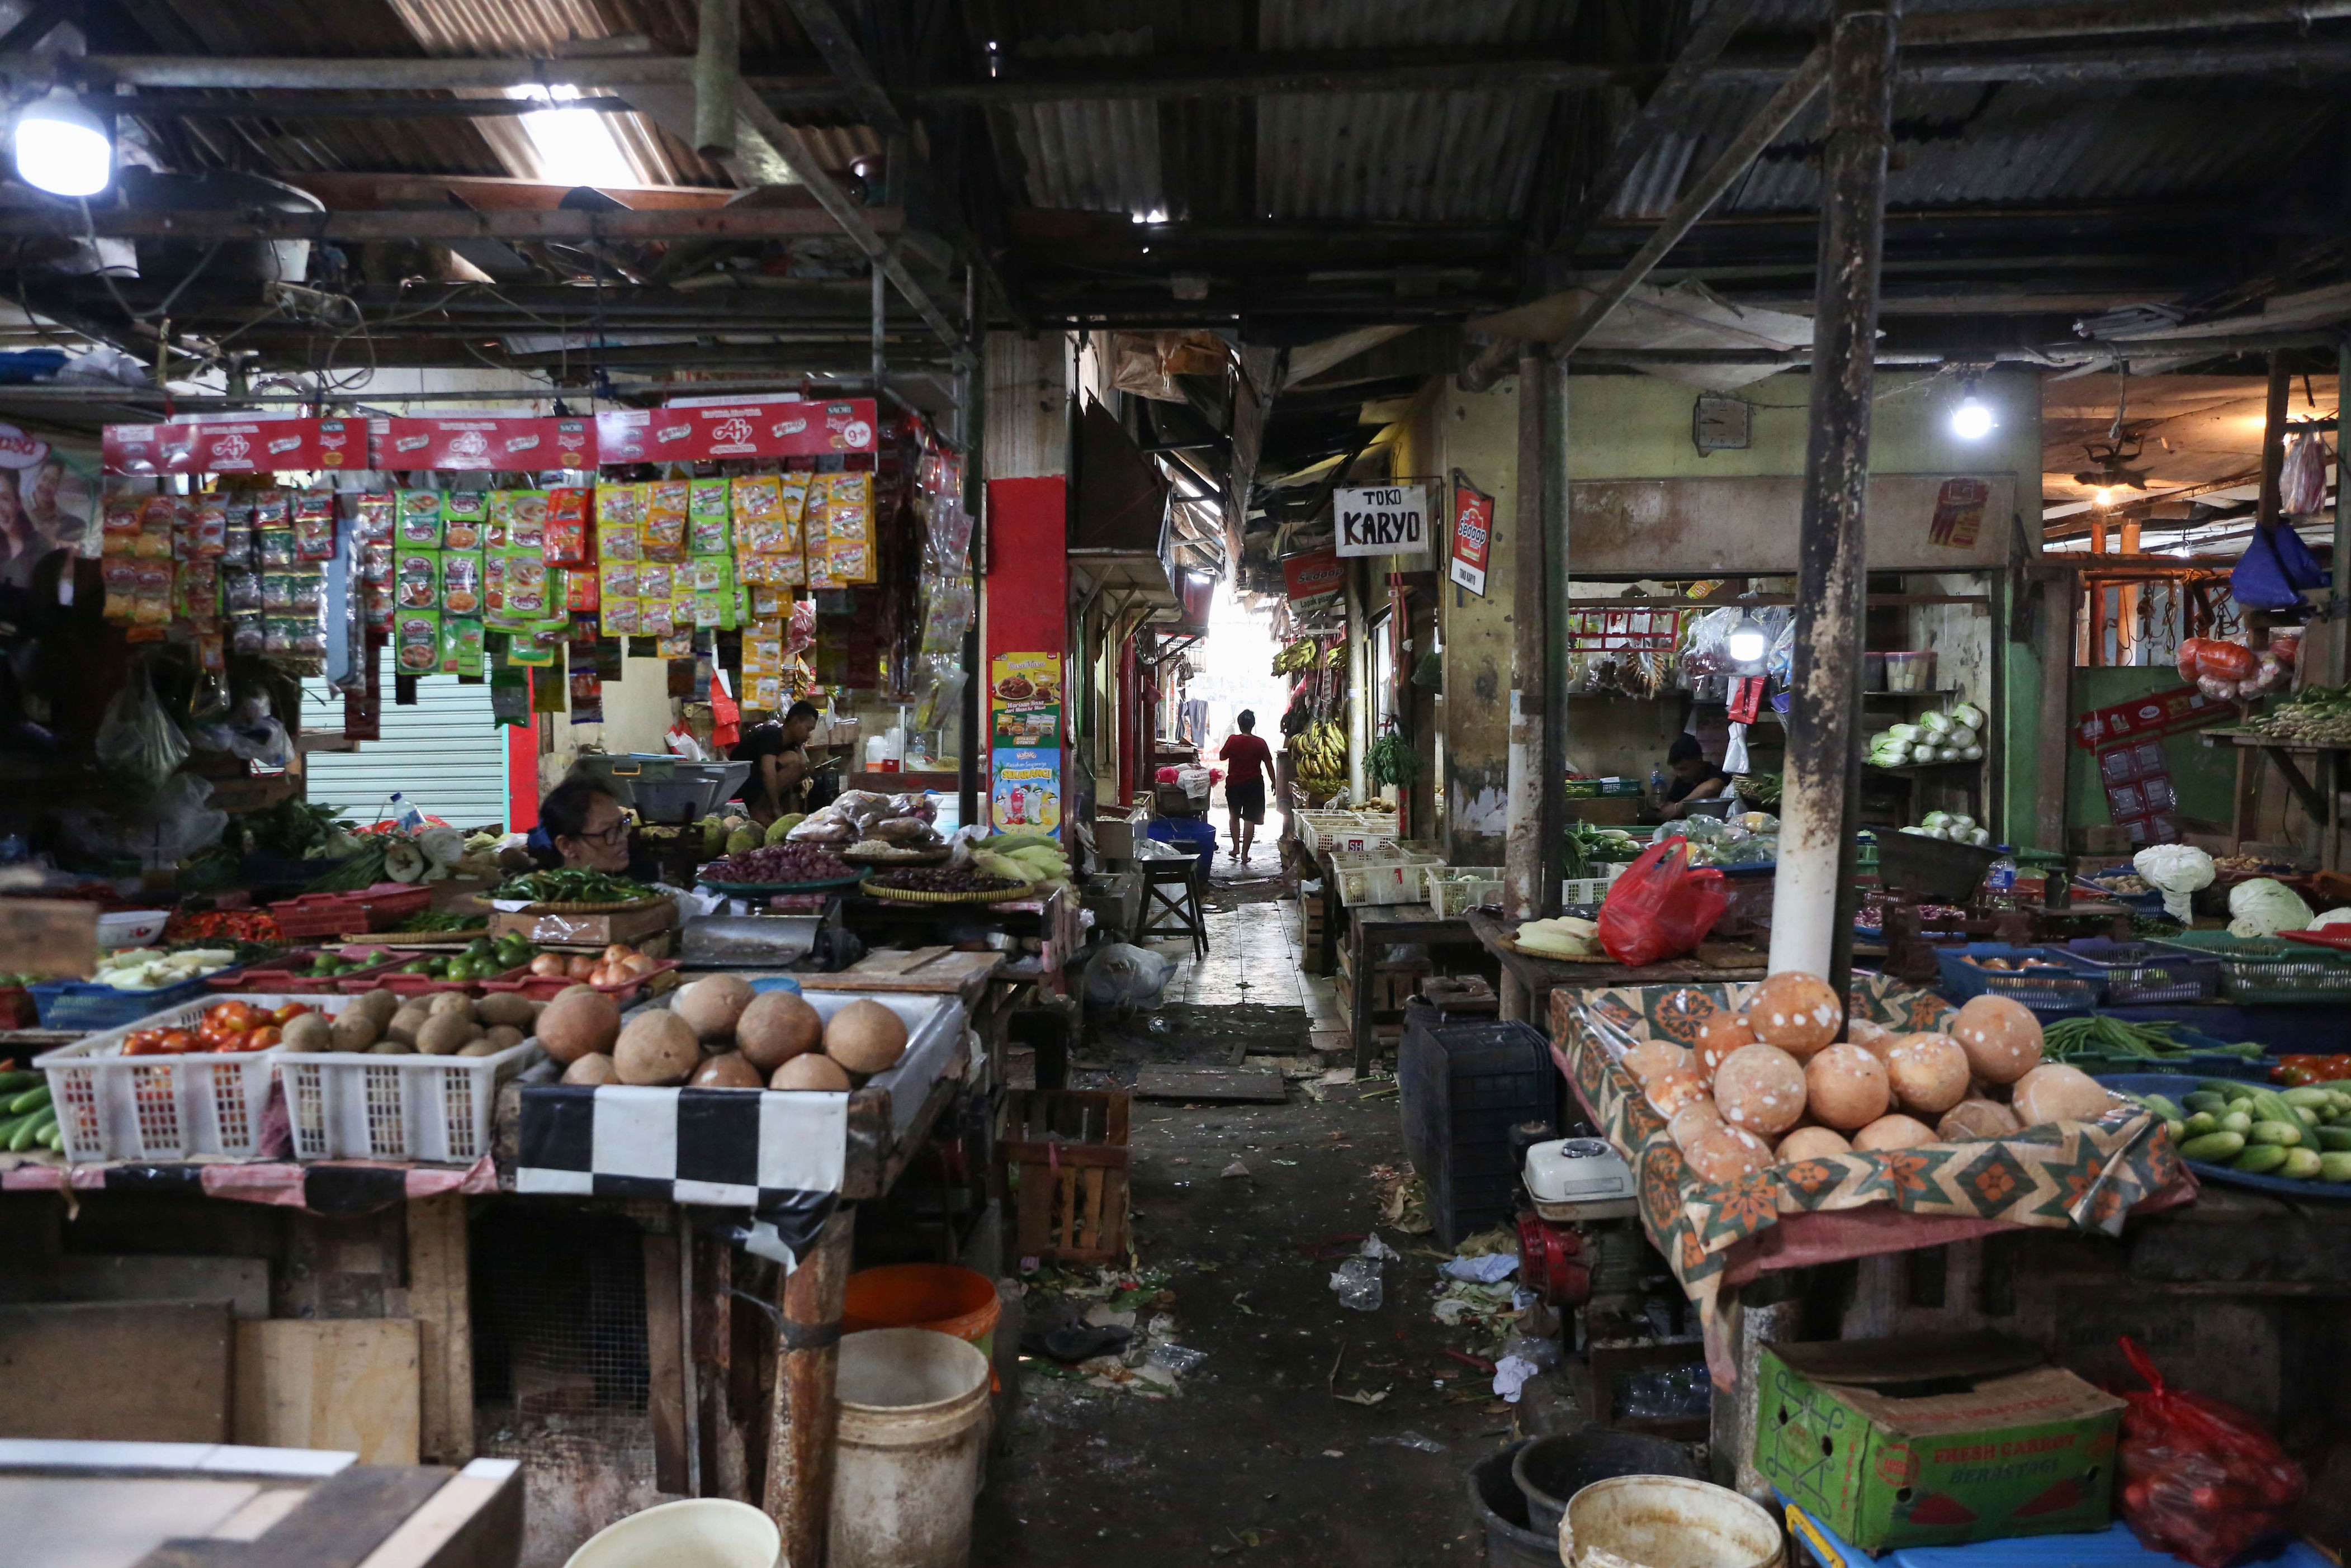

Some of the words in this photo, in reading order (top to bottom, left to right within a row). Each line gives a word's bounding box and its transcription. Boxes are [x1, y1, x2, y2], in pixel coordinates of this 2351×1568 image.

[848, 430, 857, 442] 9
[1363, 489, 1401, 505] TOKO
[1344, 511, 1420, 546] KARYO
[1458, 518, 1487, 546] Sedaap
[1298, 568, 1344, 584] Sedaap
[1467, 572, 1475, 585] KARYO
[1002, 769, 1051, 779] SEKARANG!
[1349, 842, 1362, 851] SH
[1934, 1444, 1997, 1463] FRESH
[2000, 1434, 2078, 1457] CARROT
[1951, 1458, 2059, 1484] BERASTAGI
